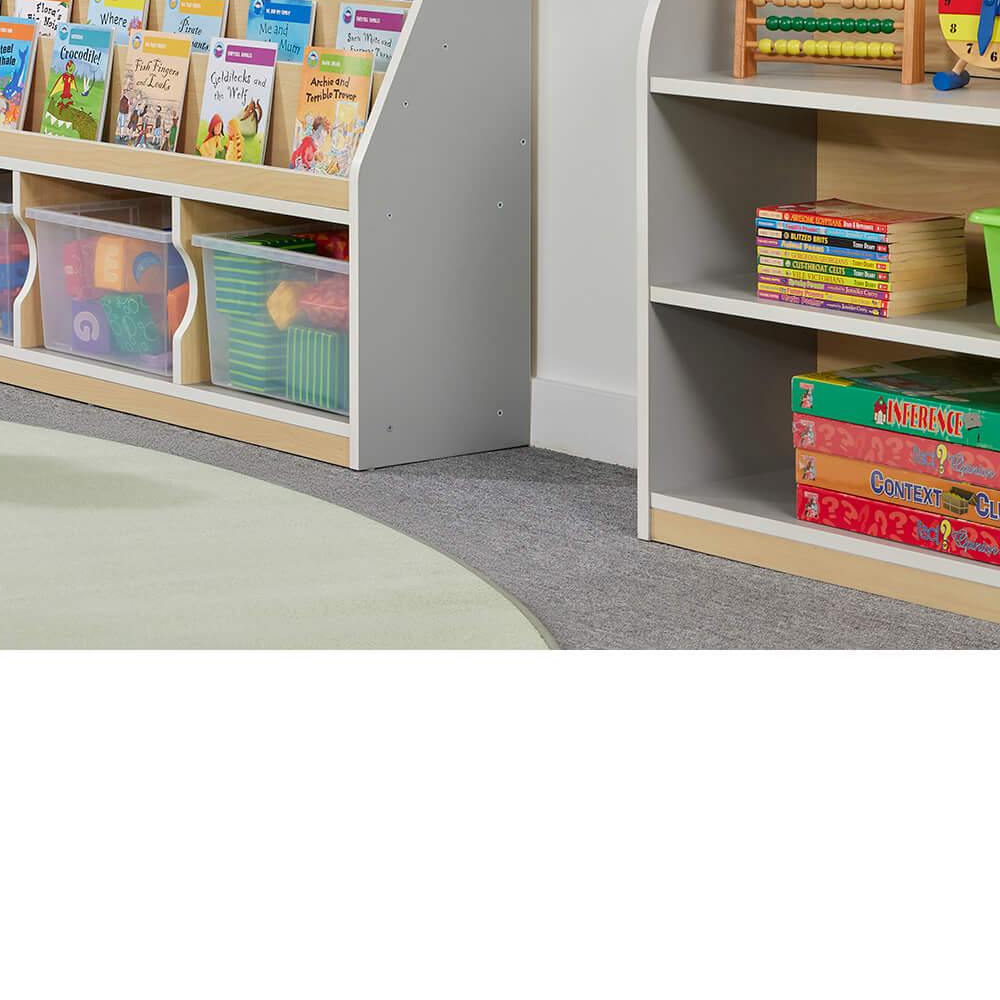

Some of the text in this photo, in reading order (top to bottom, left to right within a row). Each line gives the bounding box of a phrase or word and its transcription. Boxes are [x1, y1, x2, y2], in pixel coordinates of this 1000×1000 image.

[36, 2, 62, 20] Flora's
[100, 12, 128, 28] Where
[178, 16, 202, 36] Pirate
[259, 23, 289, 37] Me and
[950, 23, 957, 34] 8
[280, 39, 300, 55] Mum
[966, 43, 974, 54] 7
[59, 47, 101, 65] Crocodile!
[990, 51, 998, 63] 6
[135, 58, 179, 78] Fish Fingers
[254, 78, 267, 87] and
[310, 76, 350, 89] Archie and
[306, 88, 357, 103] Terrible Trevor
[790, 233, 812, 242] BLITZED
[887, 398, 964, 438] INFERENCE
[948, 452, 996, 479] Opinion
[870, 469, 943, 509] CONTEXT
[952, 528, 999, 556] Opinion
